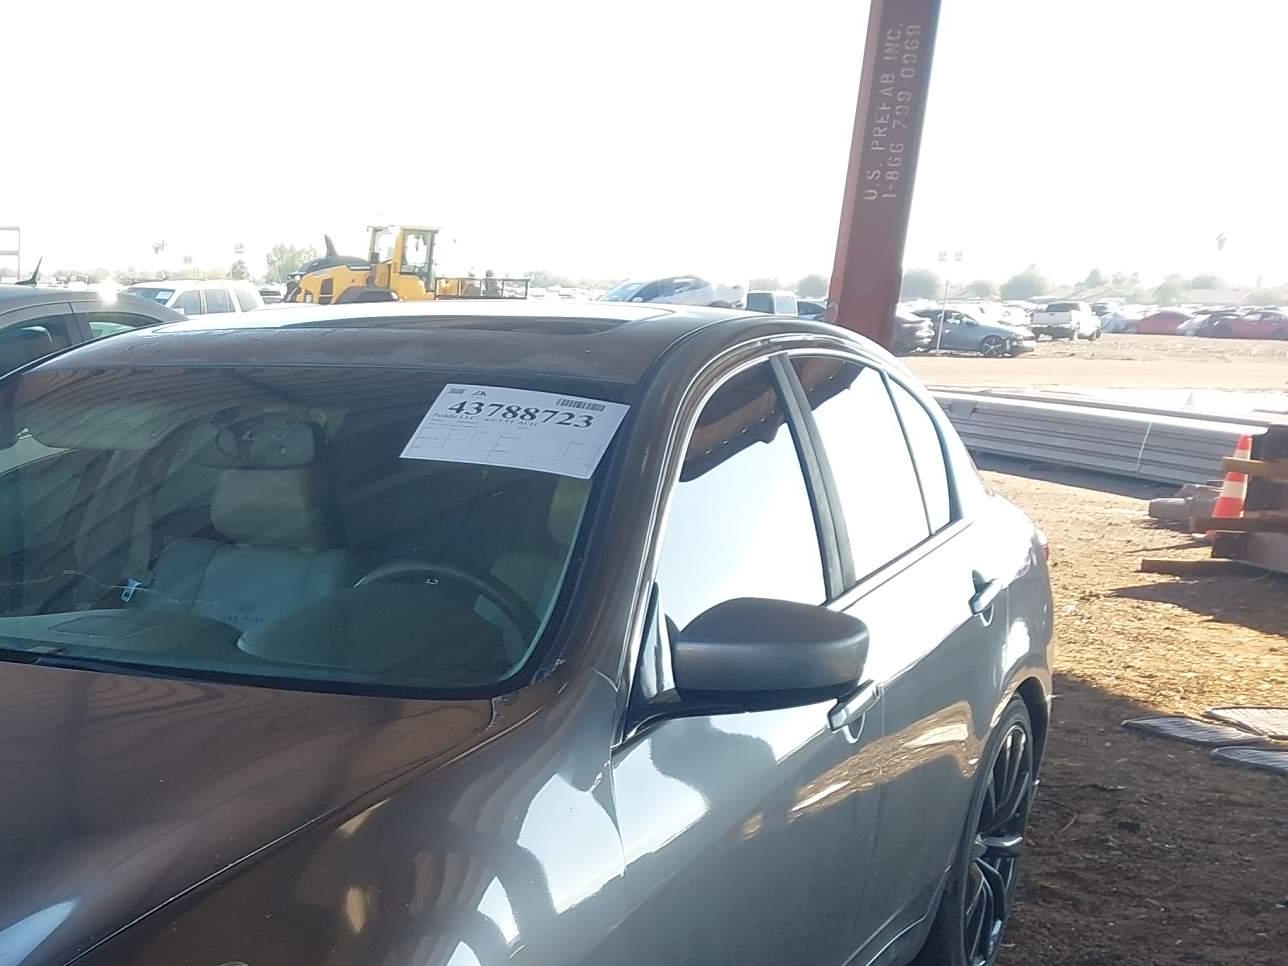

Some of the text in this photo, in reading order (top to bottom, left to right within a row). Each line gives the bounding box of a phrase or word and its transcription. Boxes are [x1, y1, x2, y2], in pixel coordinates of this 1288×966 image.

[863, 23, 904, 201] U.S. PREFAB INC.
[882, 142, 905, 199] 1-866
[448, 400, 595, 429] 43788723
